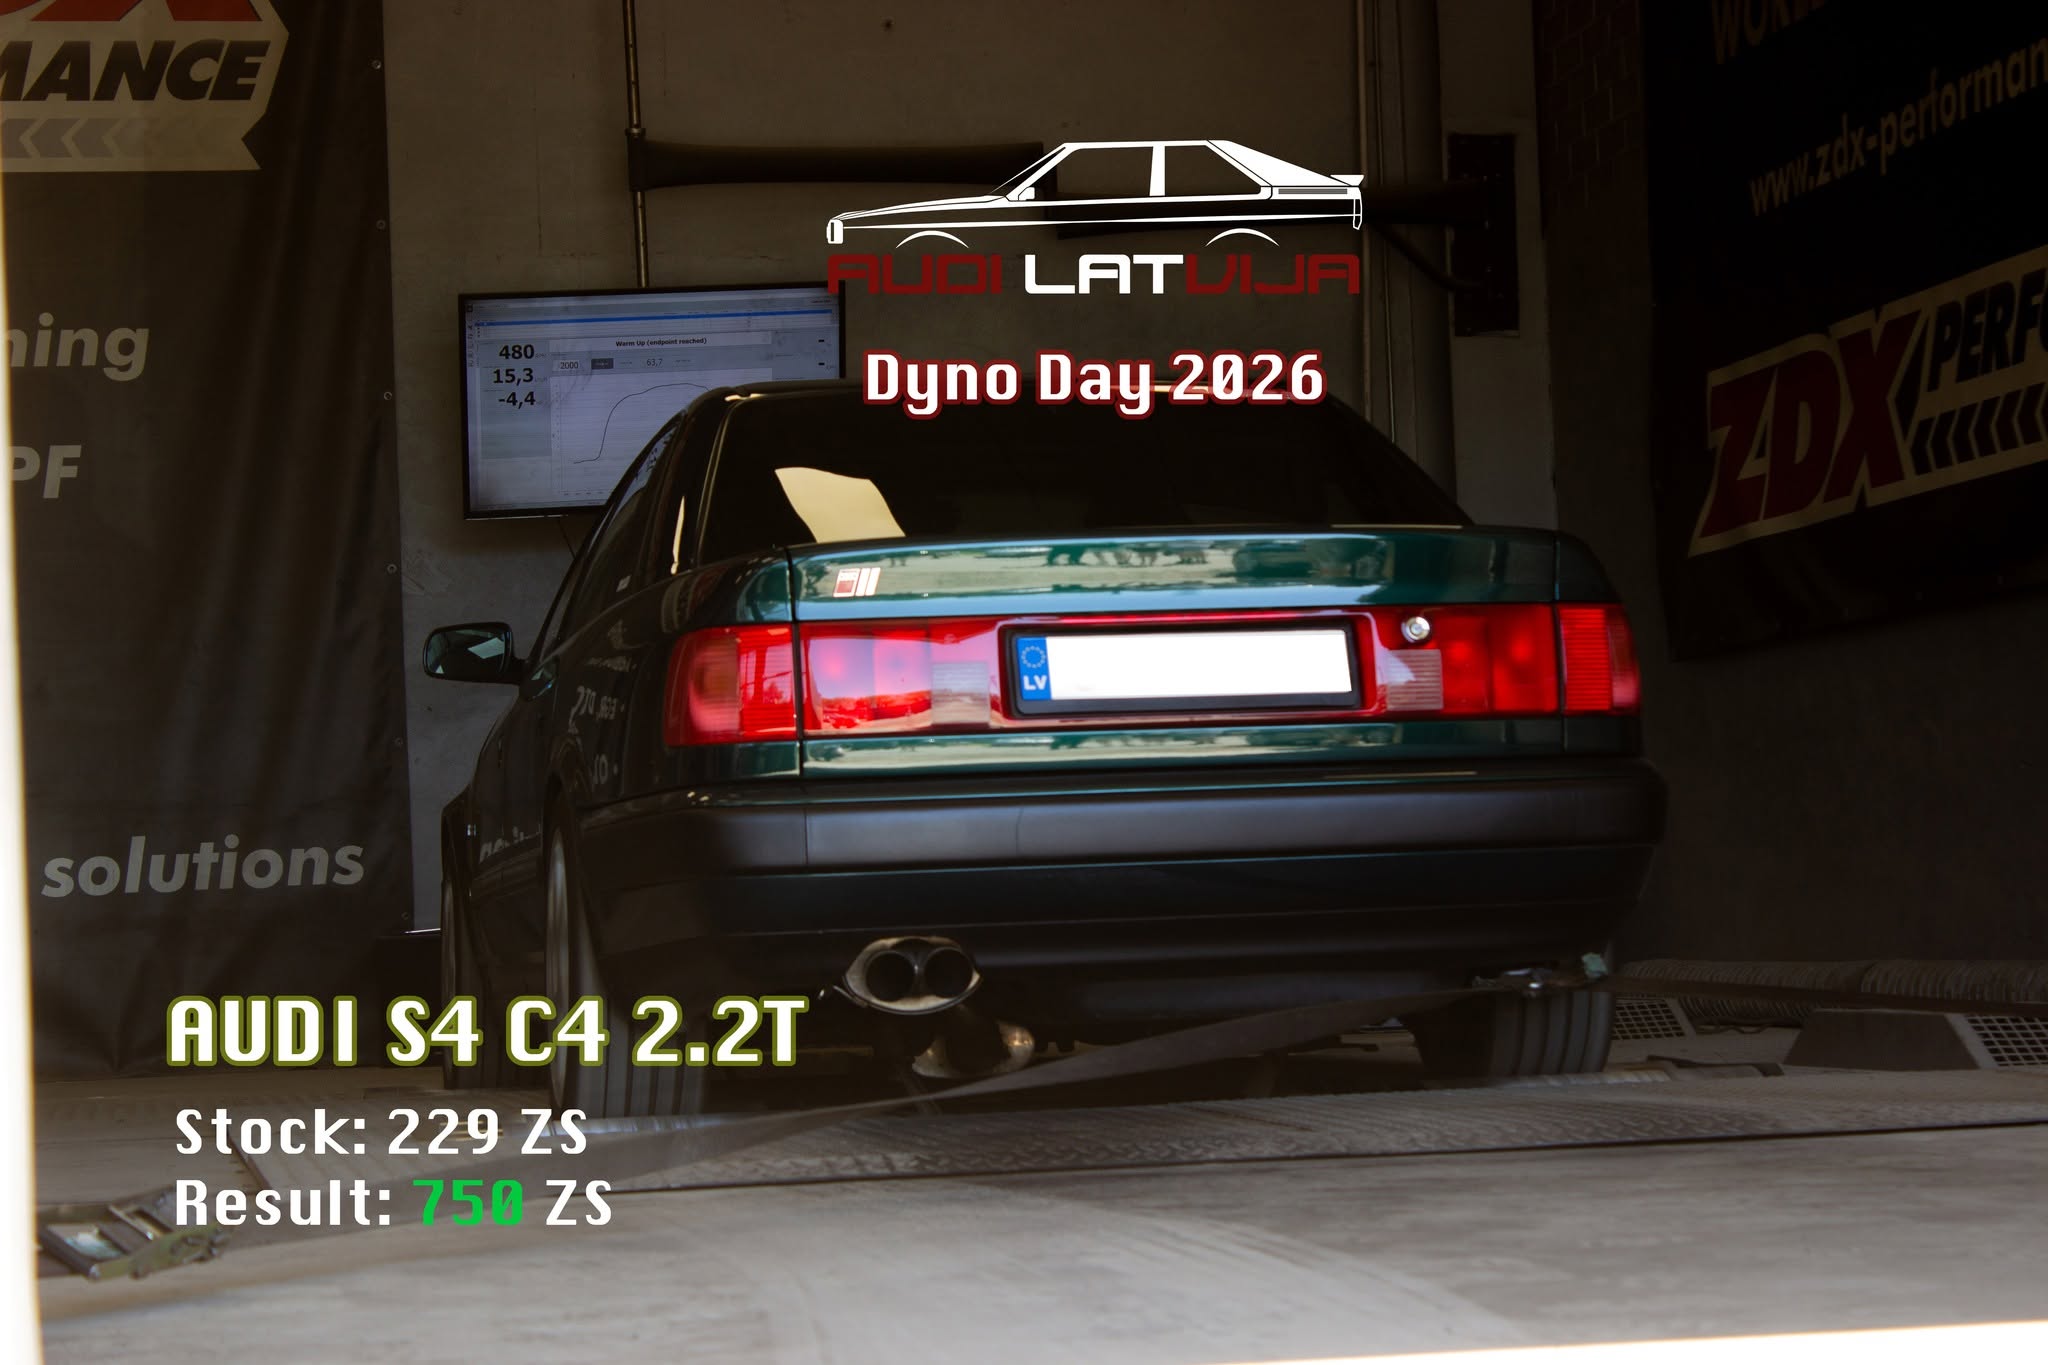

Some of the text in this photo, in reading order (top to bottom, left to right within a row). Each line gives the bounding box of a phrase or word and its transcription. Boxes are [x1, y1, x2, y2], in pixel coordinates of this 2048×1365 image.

[1927, 268, 2048, 392] PERF
[498, 344, 535, 360] 480
[560, 361, 579, 370] 2000
[646, 358, 663, 368] 63,7
[493, 367, 534, 387] 15,3
[498, 391, 536, 410] -4,4
[1698, 308, 1924, 538] ZDX
[1022, 674, 1048, 692] LV
[41, 834, 365, 898] solutions
